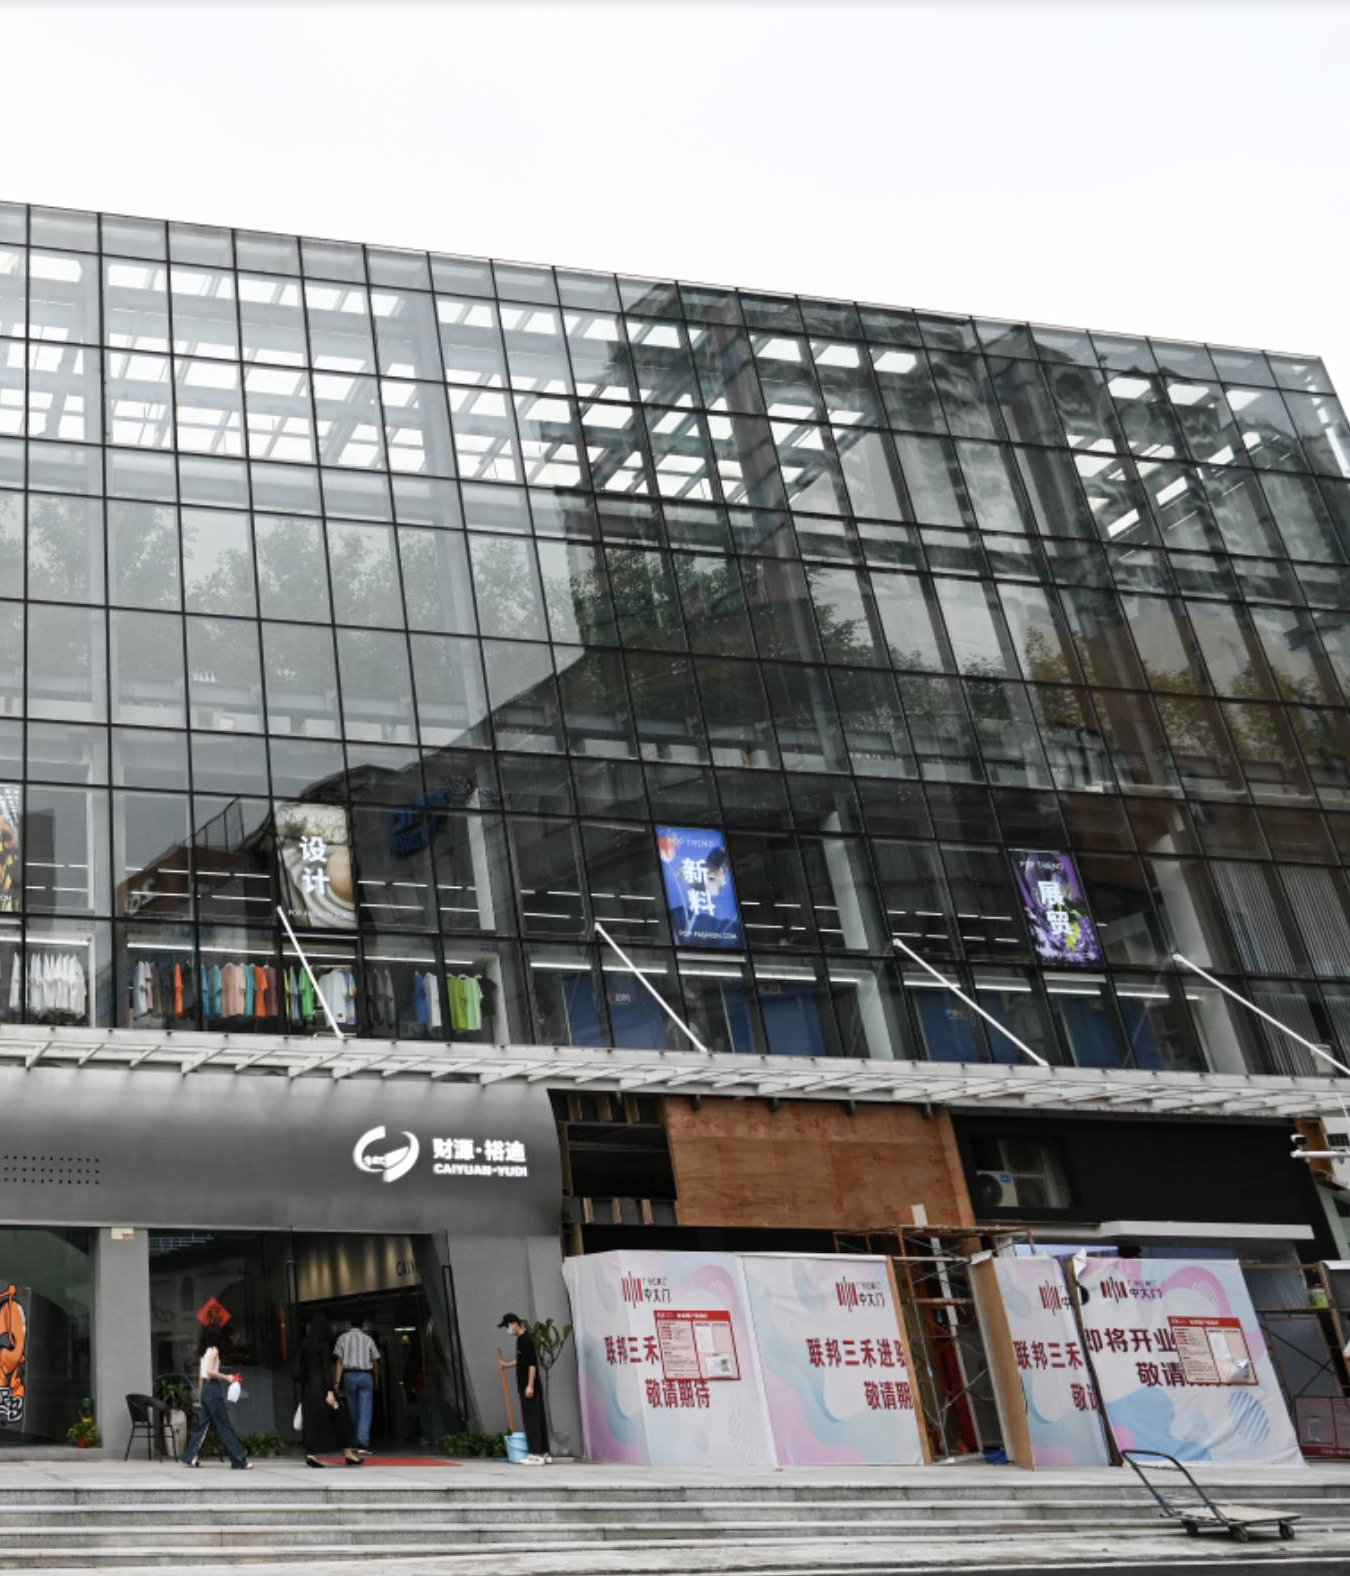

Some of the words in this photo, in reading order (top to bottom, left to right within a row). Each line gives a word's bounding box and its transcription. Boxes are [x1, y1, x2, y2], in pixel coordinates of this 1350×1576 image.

[298, 835, 330, 897] 设计
[681, 857, 716, 917] 新料
[1084, 1328, 1178, 1353] 即将开业
[644, 1378, 711, 1409] 敬请期待
